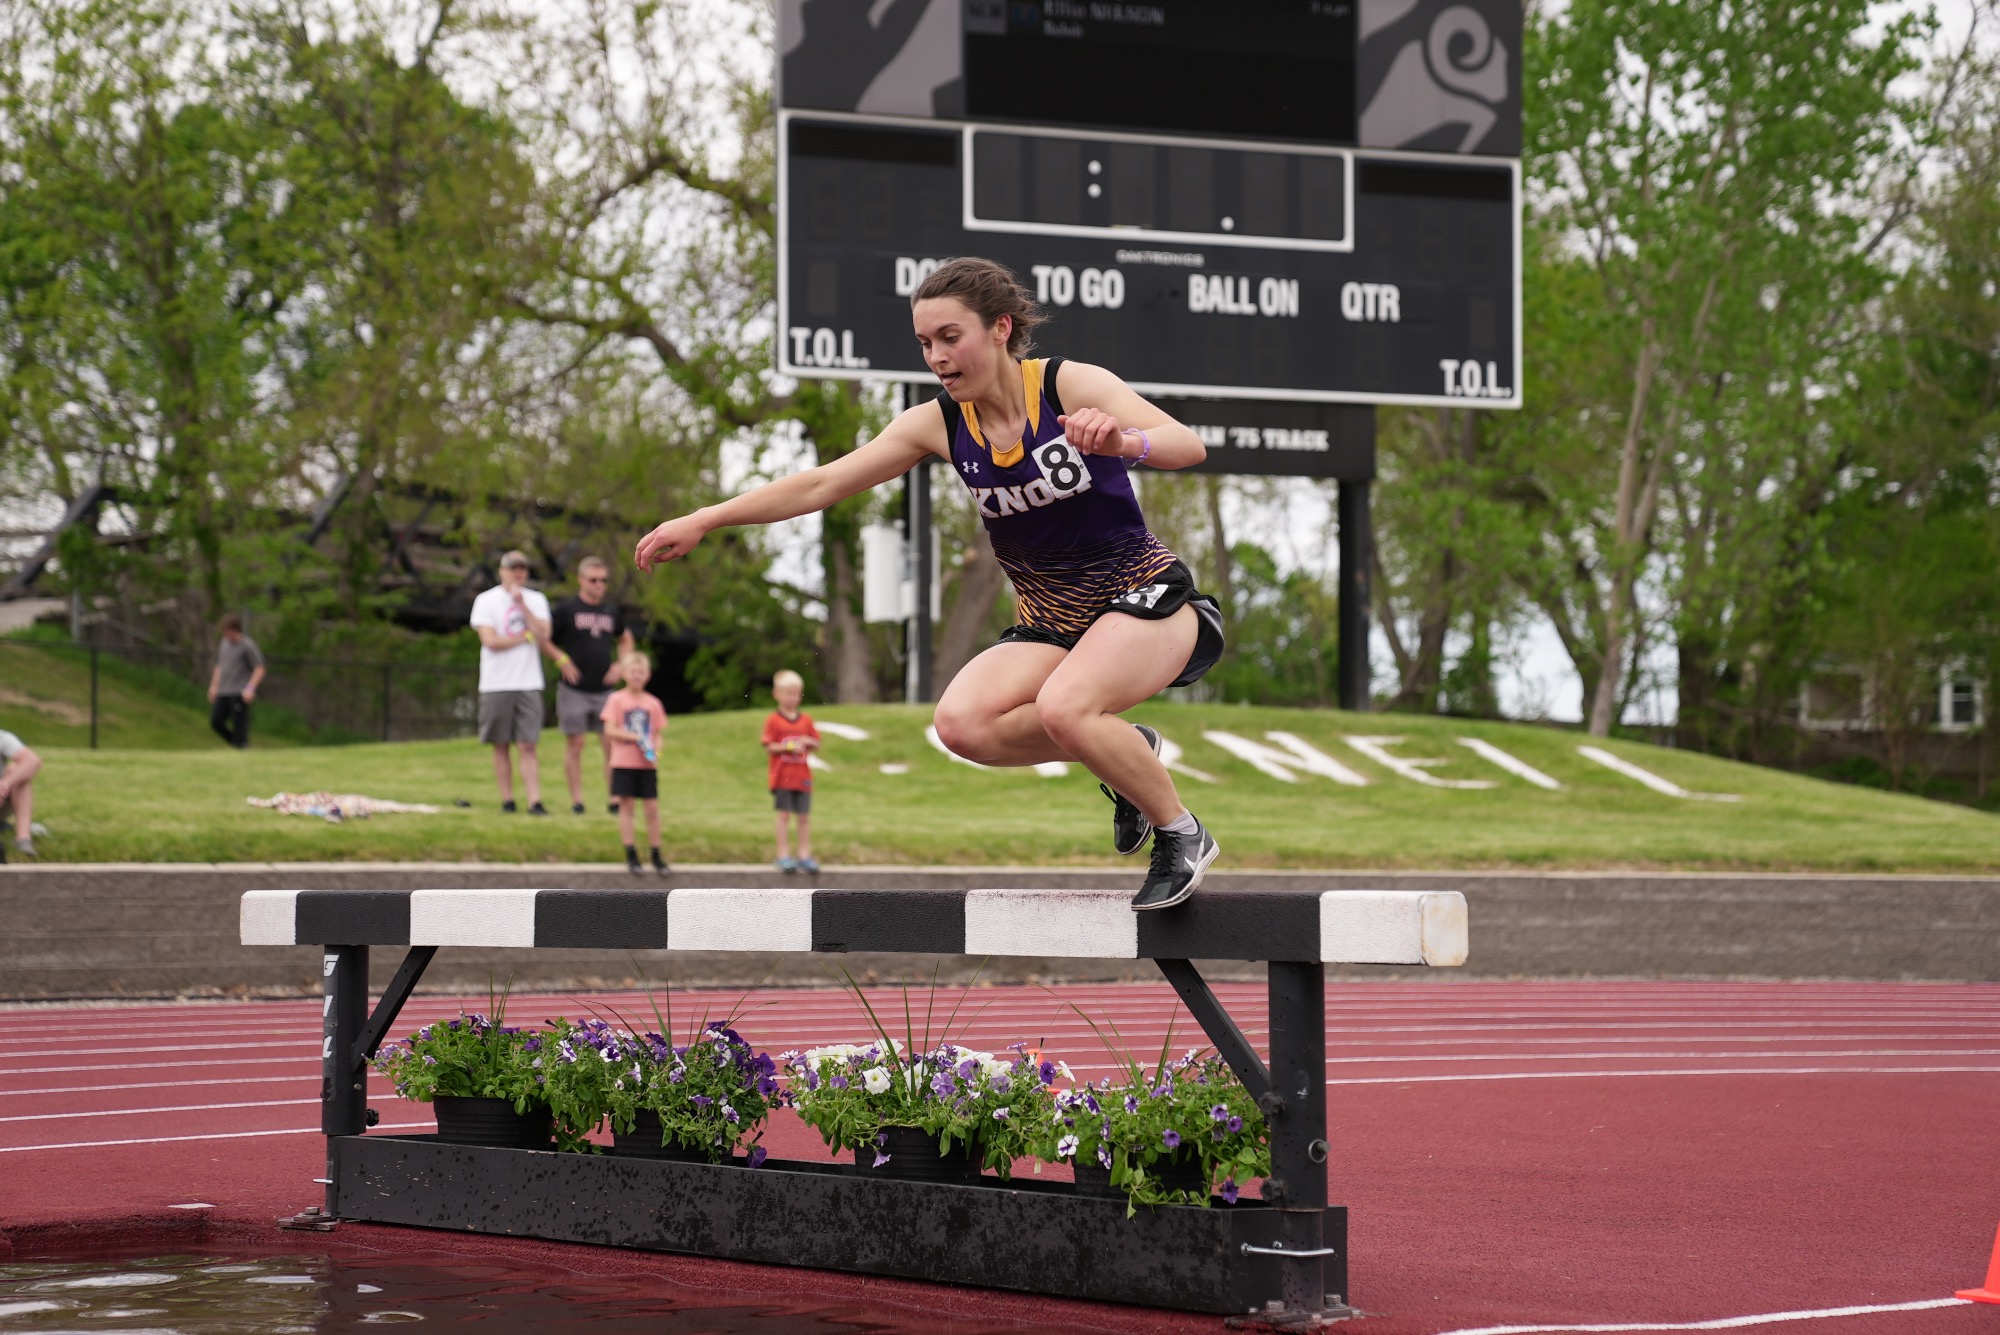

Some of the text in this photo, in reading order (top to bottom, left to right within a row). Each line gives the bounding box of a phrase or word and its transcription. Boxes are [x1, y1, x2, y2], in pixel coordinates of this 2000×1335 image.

[1031, 265, 1125, 308] TO GO
[1188, 274, 1299, 317] BALL ON
[1341, 281, 1400, 322] QTR
[789, 326, 870, 369] T.O.L.
[1439, 359, 1512, 398] T.O.L.
[1262, 428, 1330, 452] TRACK
[1041, 443, 1082, 491] 8
[969, 477, 1092, 519] KNO
